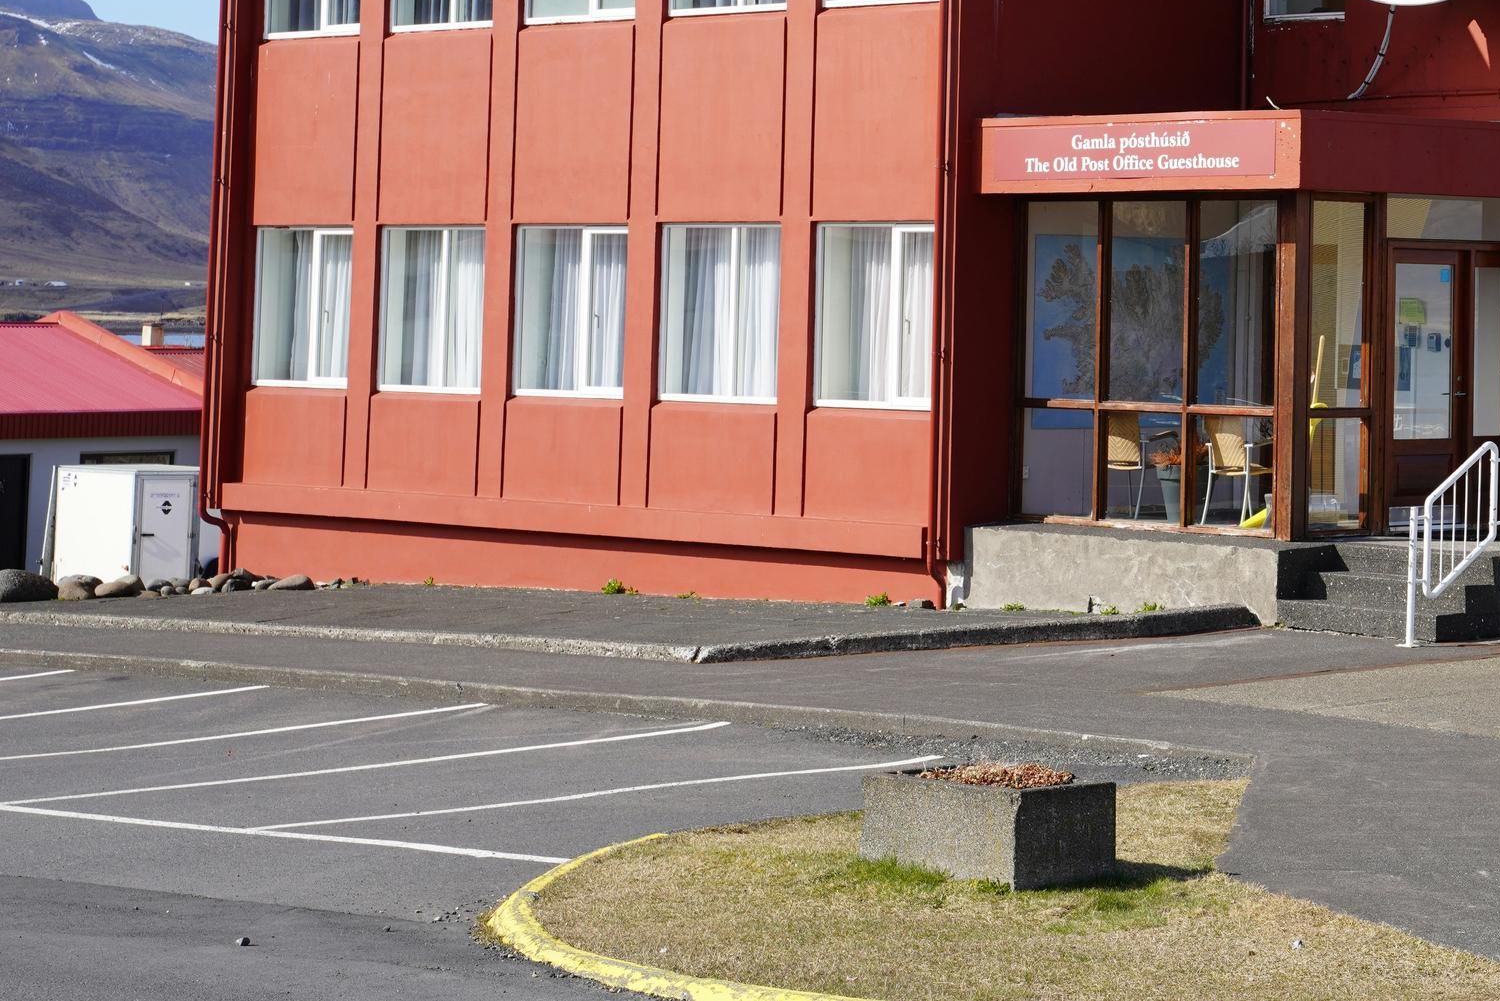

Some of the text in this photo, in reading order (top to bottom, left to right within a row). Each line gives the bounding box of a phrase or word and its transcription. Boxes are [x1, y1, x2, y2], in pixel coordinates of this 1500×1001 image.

[1071, 130, 1190, 153] Gamla pósthúsið
[1025, 153, 1240, 173] The Old Post Office Guesthouse
